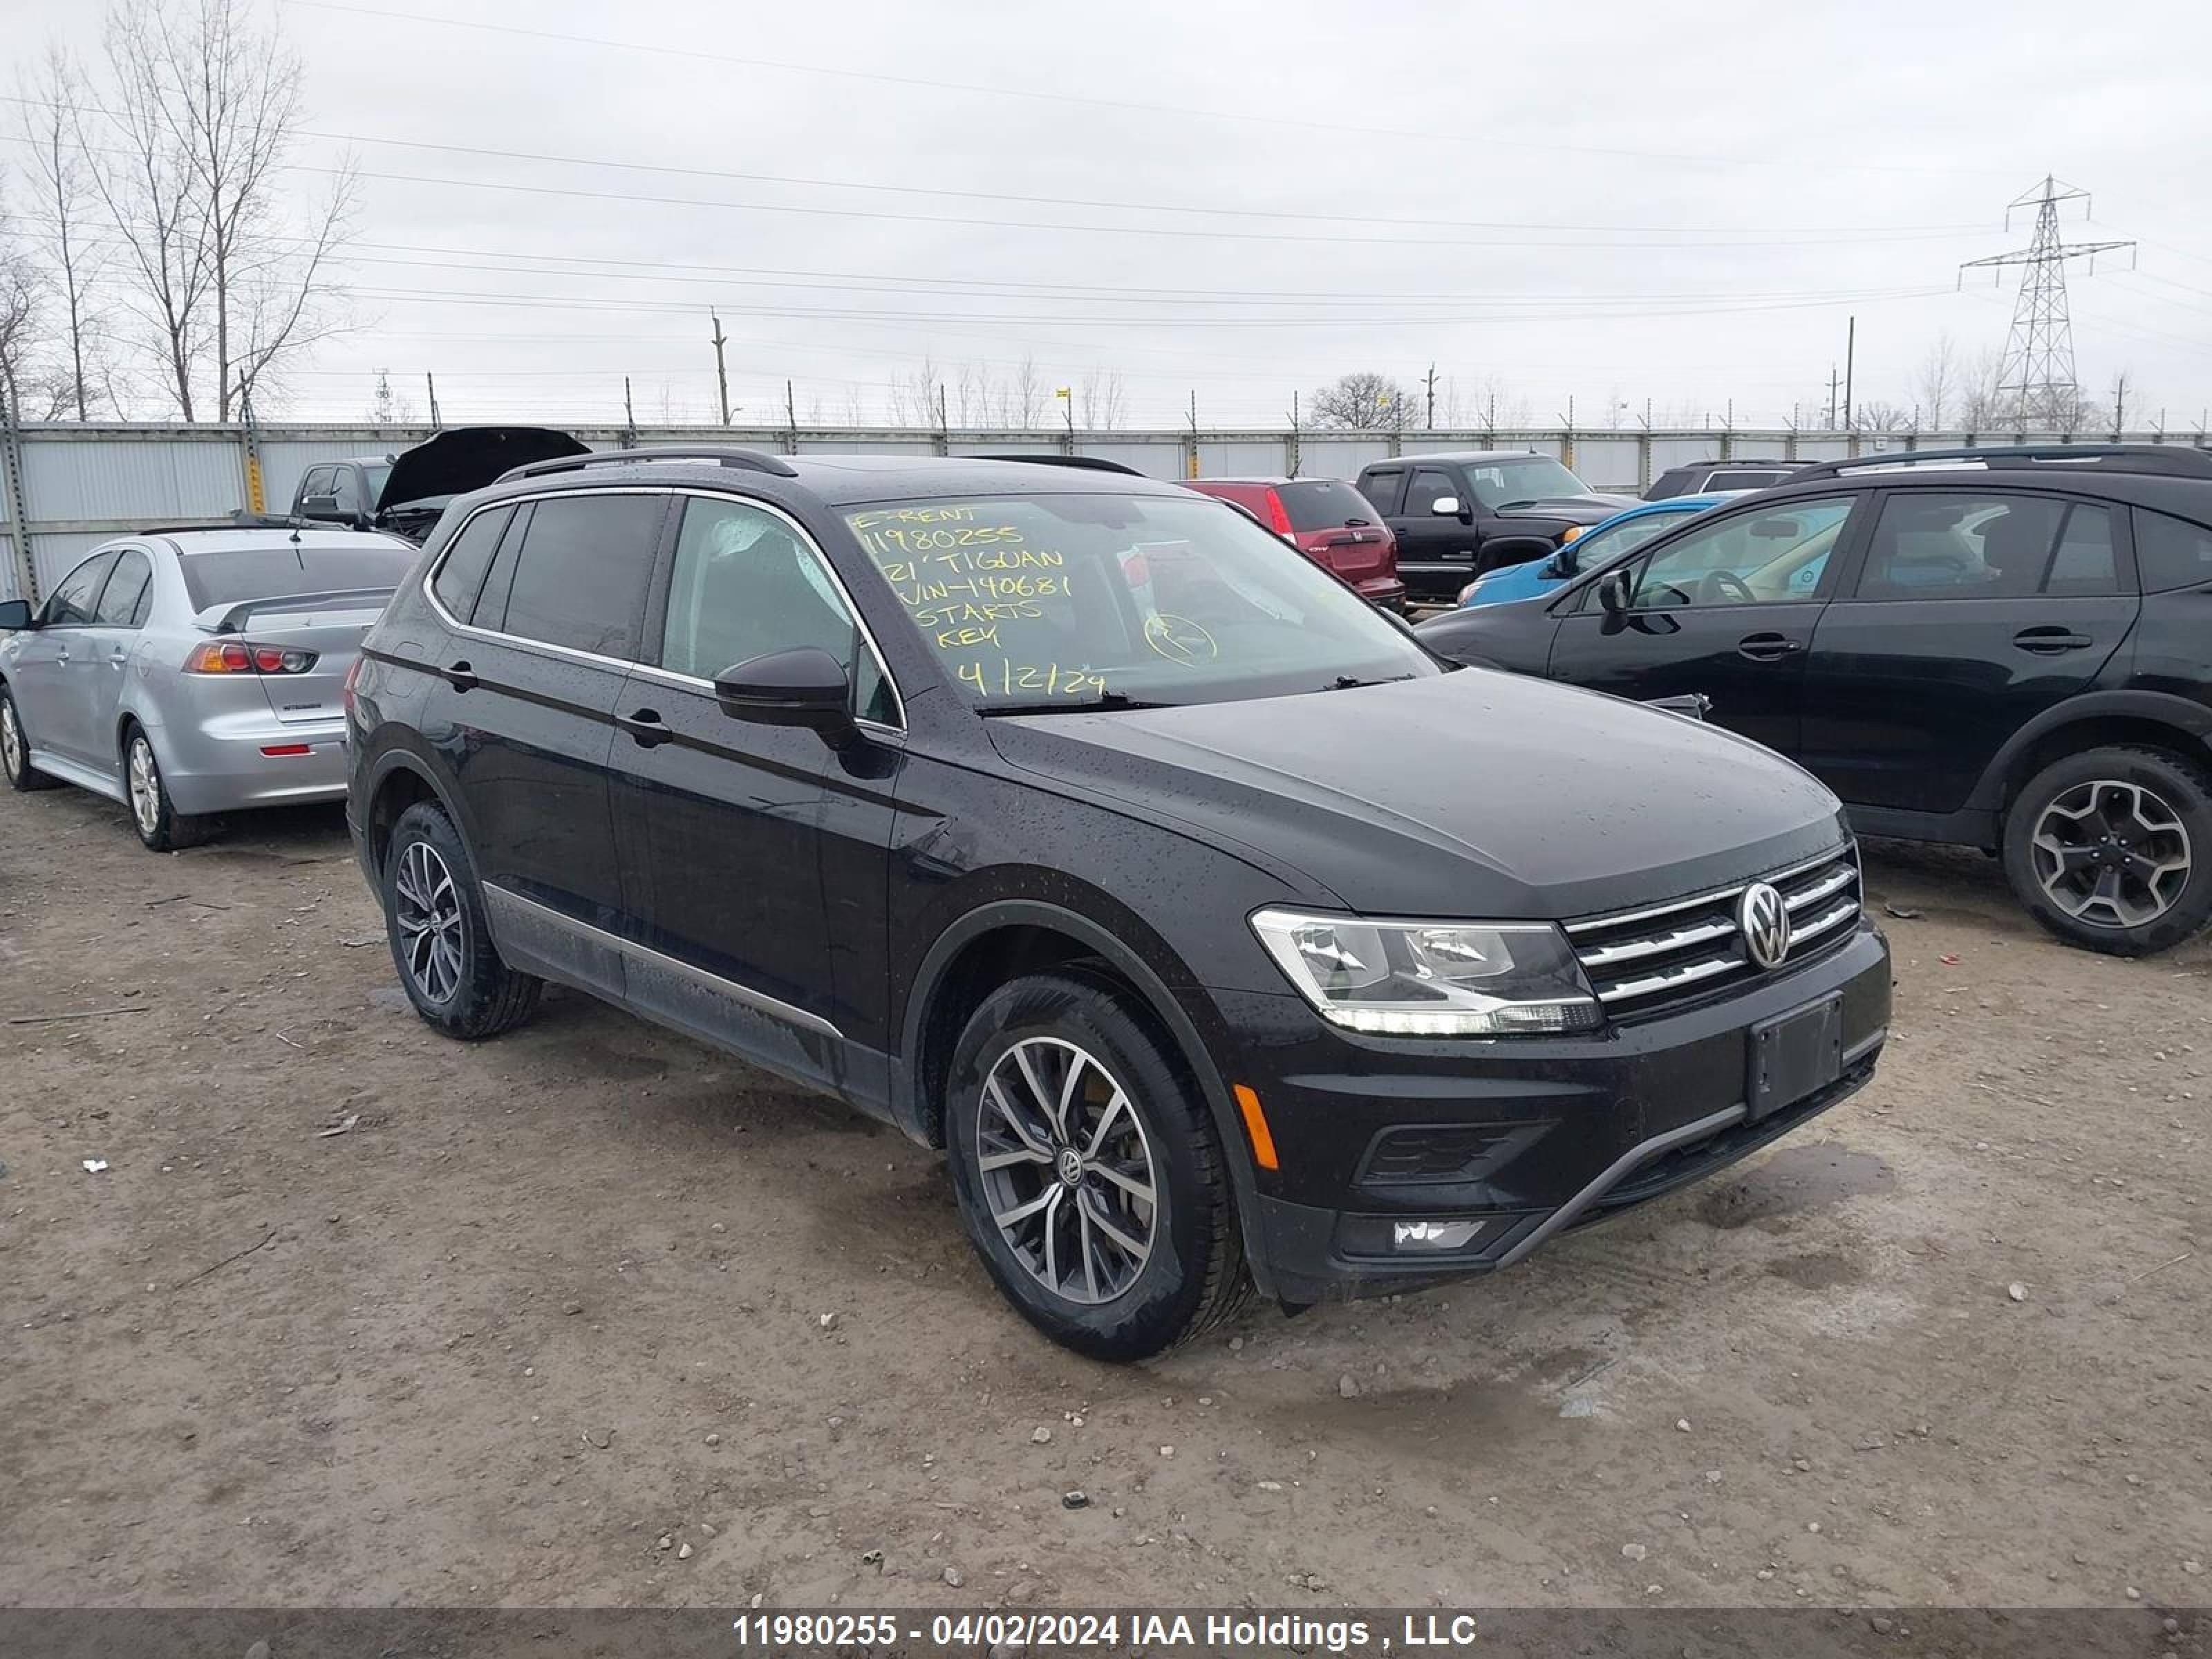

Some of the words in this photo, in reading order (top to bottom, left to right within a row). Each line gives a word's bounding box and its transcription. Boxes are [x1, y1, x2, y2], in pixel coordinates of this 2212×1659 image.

[863, 526, 1024, 554] 11980255
[935, 550, 1063, 575] TIGUAN
[915, 599, 1042, 627] STARTS
[935, 625, 1002, 648] KEY
